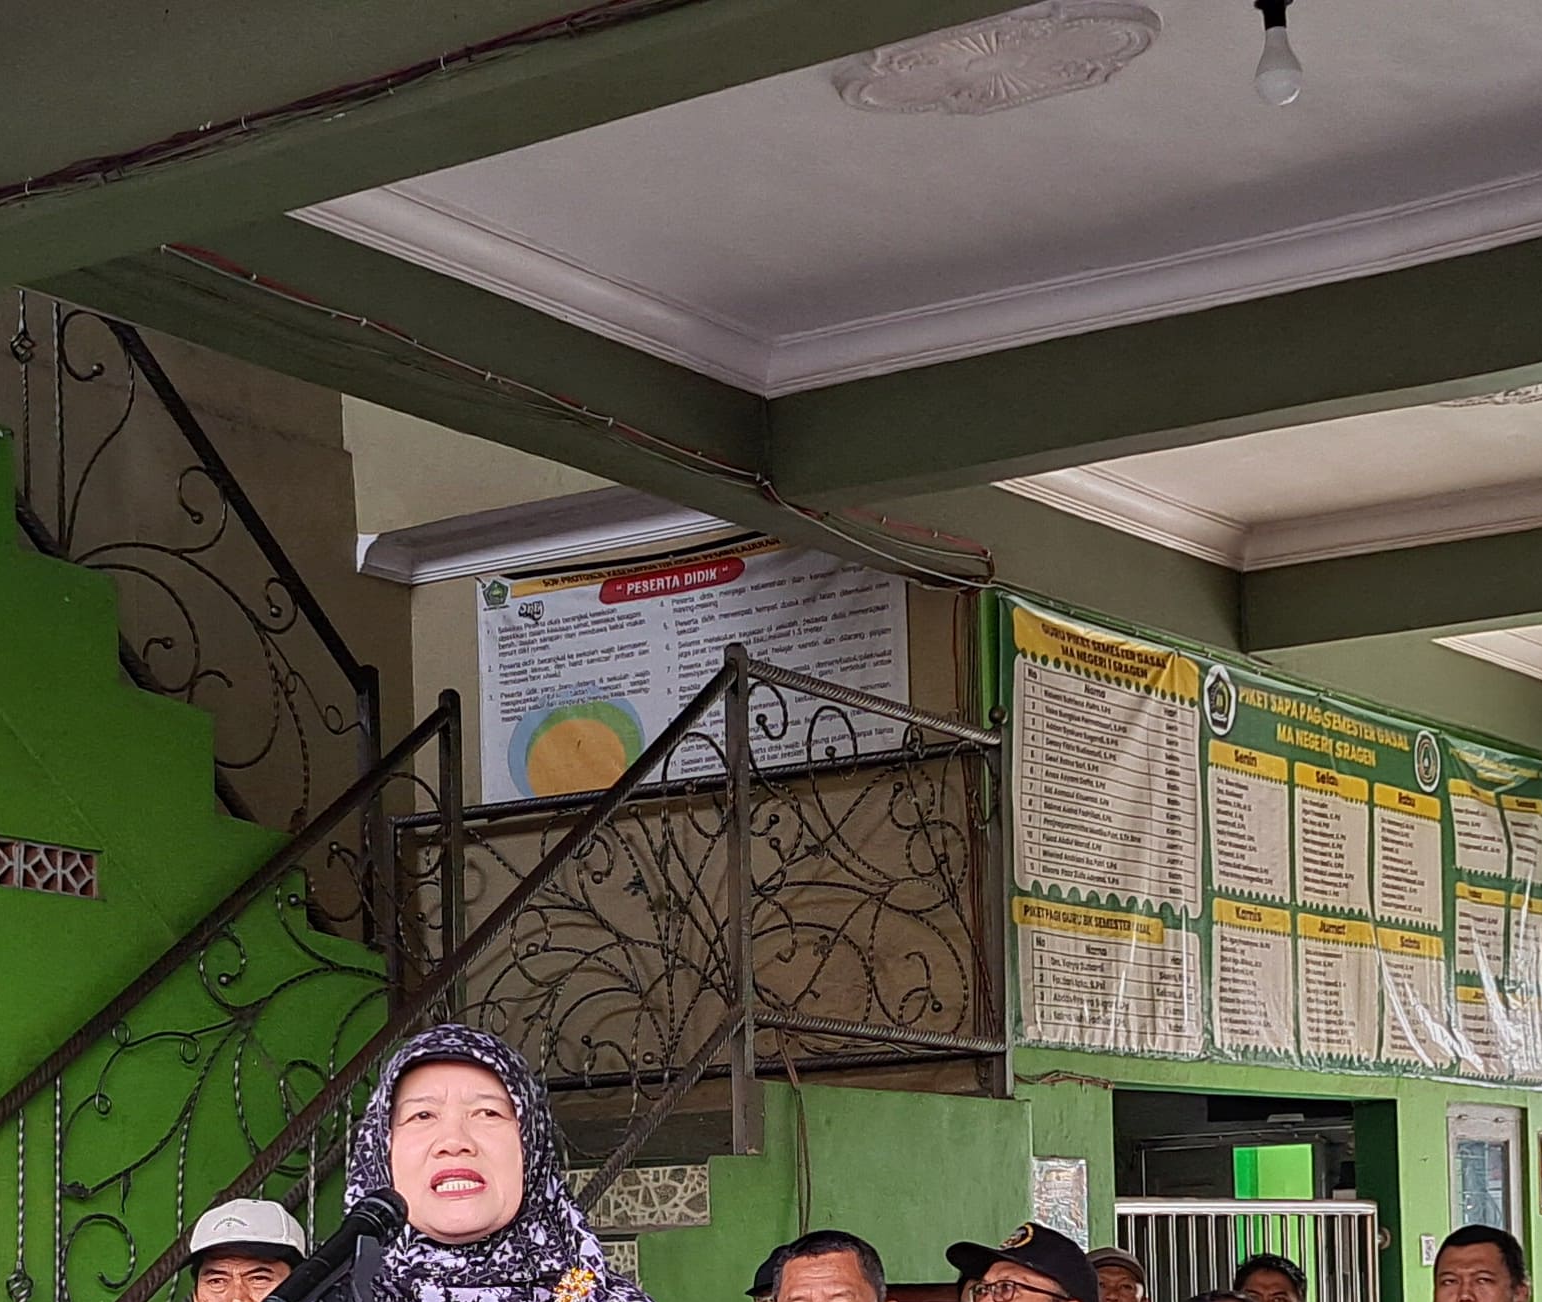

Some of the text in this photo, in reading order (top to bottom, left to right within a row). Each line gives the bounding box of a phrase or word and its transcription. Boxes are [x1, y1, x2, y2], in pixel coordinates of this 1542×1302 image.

[626, 567, 718, 596] PESERTA DIDIK
[1076, 648, 1107, 668] NEGERI
[1113, 658, 1148, 680] SRAGEN
[1237, 686, 1268, 710] PIKET
[1270, 694, 1298, 719] SAPA
[1322, 710, 1376, 742] SEMESTER
[1234, 749, 1258, 768] Senin
[1276, 722, 1295, 746] MA
[1335, 740, 1376, 768] SRAGEN
[1024, 904, 1046, 919] PIKET
[1061, 911, 1082, 926] GURU
[1095, 915, 1132, 931] SEMESTER
